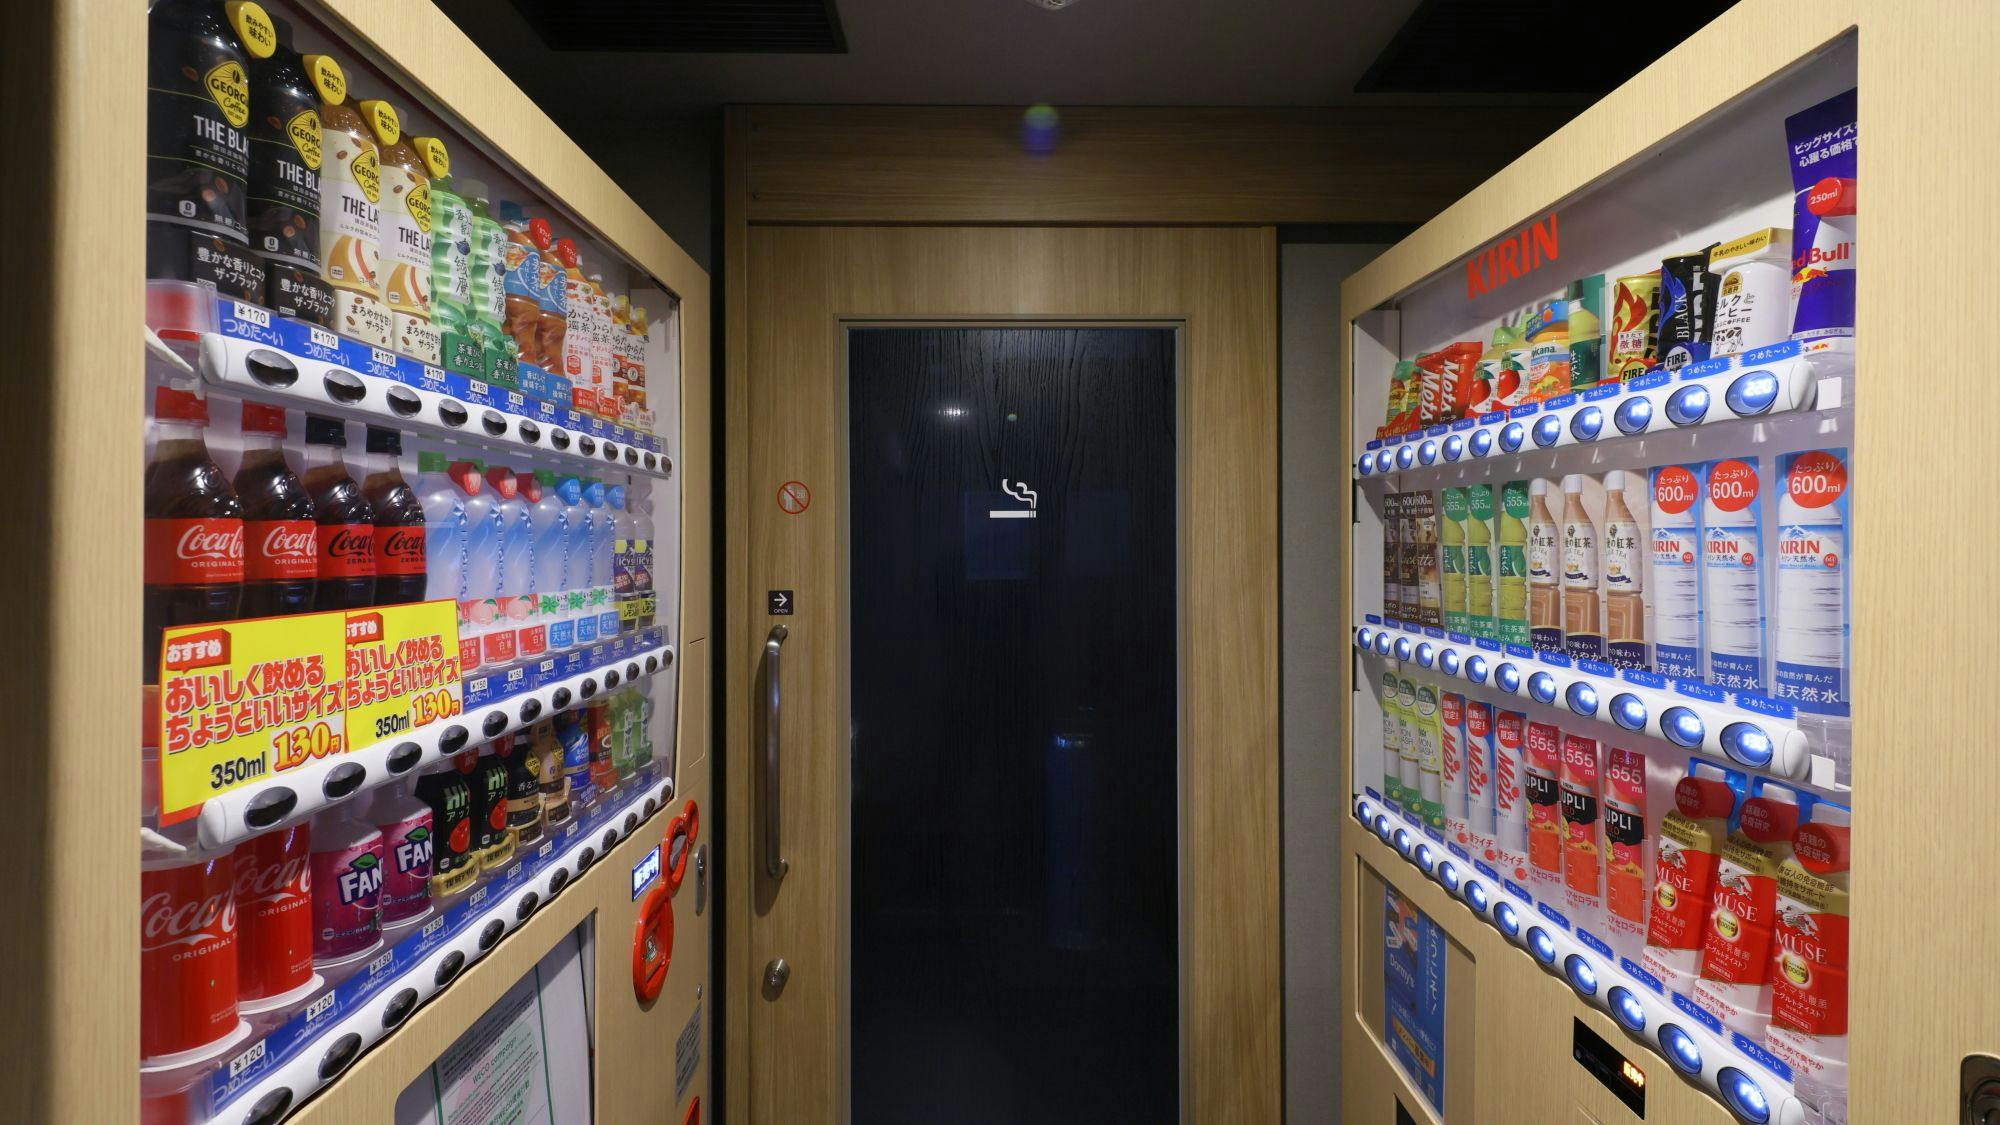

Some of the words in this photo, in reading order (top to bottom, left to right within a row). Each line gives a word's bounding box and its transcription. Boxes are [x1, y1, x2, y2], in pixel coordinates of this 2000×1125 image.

[248, 26, 271, 47] 味わい
[193, 115, 225, 144] THE
[1795, 122, 1857, 155] ビッグサイズ
[277, 159, 303, 186] THE
[1811, 188, 1838, 205] 250ml
[342, 195, 366, 221] THE
[398, 227, 419, 247] THE
[1466, 212, 1559, 300] KIRIN
[1808, 242, 1849, 265] Bull
[214, 267, 258, 291] ザ・ブラック
[238, 304, 267, 325] ¥170
[295, 295, 329, 316] ザ・ブラック
[1674, 294, 1690, 340] BLACK
[223, 318, 284, 347] つめた〜い
[313, 331, 337, 347] ¥170
[303, 342, 350, 366] つめた〜い
[1620, 339, 1642, 349] 微糖
[1749, 344, 1790, 361] つめた〜い
[374, 352, 394, 365] ¥170
[1666, 351, 1688, 368] FIRE
[1686, 360, 1722, 376] つめた〜い
[426, 369, 444, 380] ¥170
[1623, 367, 1646, 381] FIRE
[1634, 374, 1664, 388] つめた〜い
[1421, 369, 1440, 420] Mets
[1441, 359, 1460, 412] Mets
[1588, 386, 1614, 398] つめた〜い
[1548, 397, 1572, 407] つめた〜い
[1713, 468, 1752, 481] たっぷり
[1793, 461, 1836, 475] たっぷり
[1659, 475, 1689, 485] たっぷり
[1712, 481, 1755, 499] 600ml
[1791, 473, 1841, 495] 600ml
[1658, 486, 1694, 503] 600ml
[1781, 539, 1820, 554] KIRIN
[191, 559, 238, 569] ORIGINAL
[274, 558, 312, 566] ORIGINAL
[166, 638, 222, 664] おすすめ
[1544, 653, 1566, 664] つめた〜い
[1582, 661, 1608, 673] つめた〜い
[1628, 670, 1658, 684] つめた〜い
[165, 655, 324, 714] おいしく飲める
[346, 655, 461, 709] ちょうどいいサイズ
[471, 680, 487, 691] ¥150
[1682, 683, 1716, 697] つめた〜い
[376, 710, 410, 739] 350ml
[412, 688, 461, 729] 130円
[1743, 697, 1784, 713] つめた〜い
[165, 680, 344, 755] ちょうどいいサイズ
[1530, 736, 1556, 752] 555
[210, 751, 266, 790] 350ml
[273, 721, 341, 773] 130円
[1442, 726, 1457, 783] Mets
[1547, 753, 1557, 761] ml
[1566, 750, 1595, 768] 555
[1468, 737, 1487, 797] Mets
[1611, 766, 1642, 784] 555
[1498, 747, 1517, 812] Mets
[1631, 785, 1643, 793] ml
[1799, 832, 1826, 849] 話題の
[1656, 865, 1694, 892] MUSE
[258, 898, 307, 918] ORIGINAL
[1713, 891, 1758, 922] MUSE
[424, 918, 443, 936] ¥130
[172, 938, 231, 961] ORIGINAL
[1580, 931, 1607, 954] つめた〜い
[1775, 928, 1828, 965] MUSE
[372, 954, 392, 972] ¥130
[1626, 962, 1656, 987] つめた〜い
[310, 993, 333, 1015] ¥120
[1678, 998, 1714, 1024] つめた〜い
[234, 1045, 264, 1072] ¥120
[1740, 1039, 1782, 1073] つめた〜い
